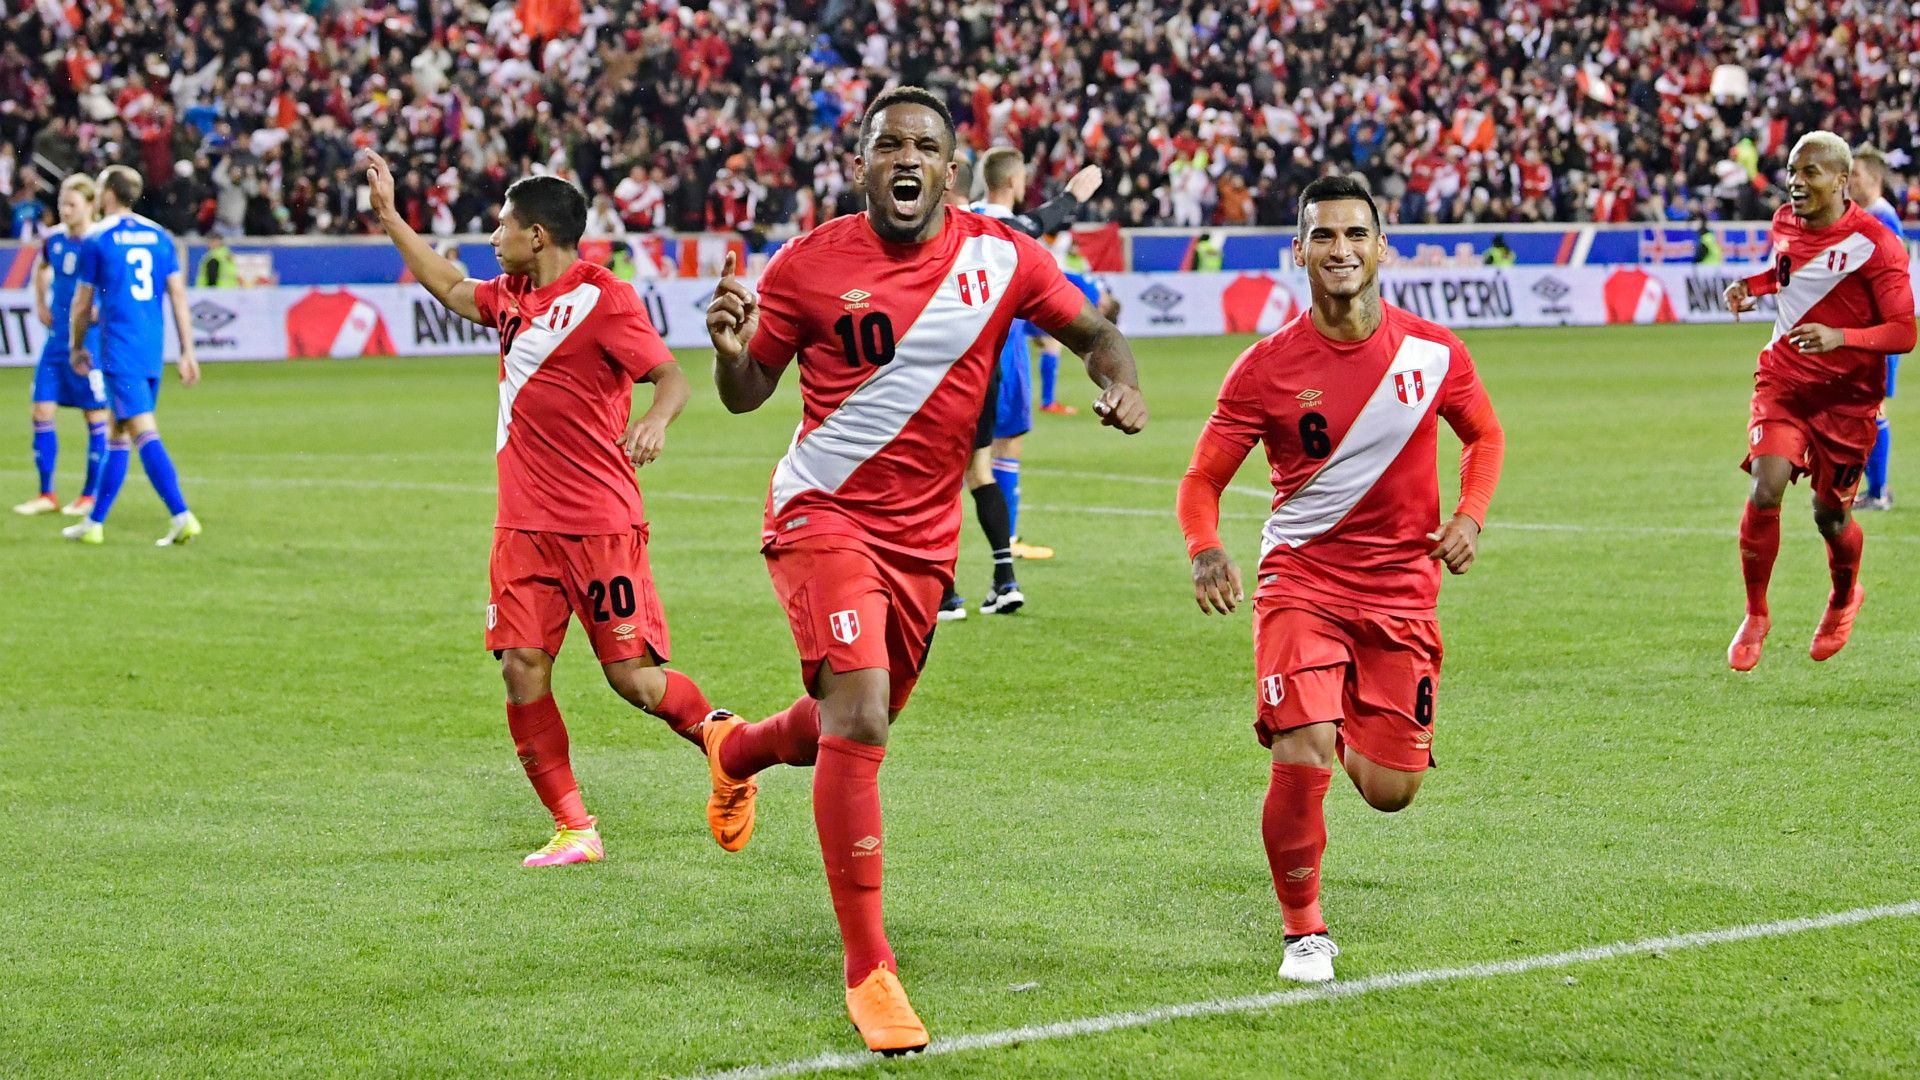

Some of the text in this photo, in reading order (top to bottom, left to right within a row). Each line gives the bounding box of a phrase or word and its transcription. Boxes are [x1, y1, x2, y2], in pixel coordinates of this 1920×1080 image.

[126, 247, 153, 301] 3
[1393, 271, 1513, 318] KIT PERÚ
[0, 309, 31, 354] IT
[834, 312, 896, 368] 10
[1300, 400, 1322, 409] umbro
[1299, 412, 1332, 459] 6
[587, 576, 636, 623] 20
[1415, 676, 1432, 726] 6
